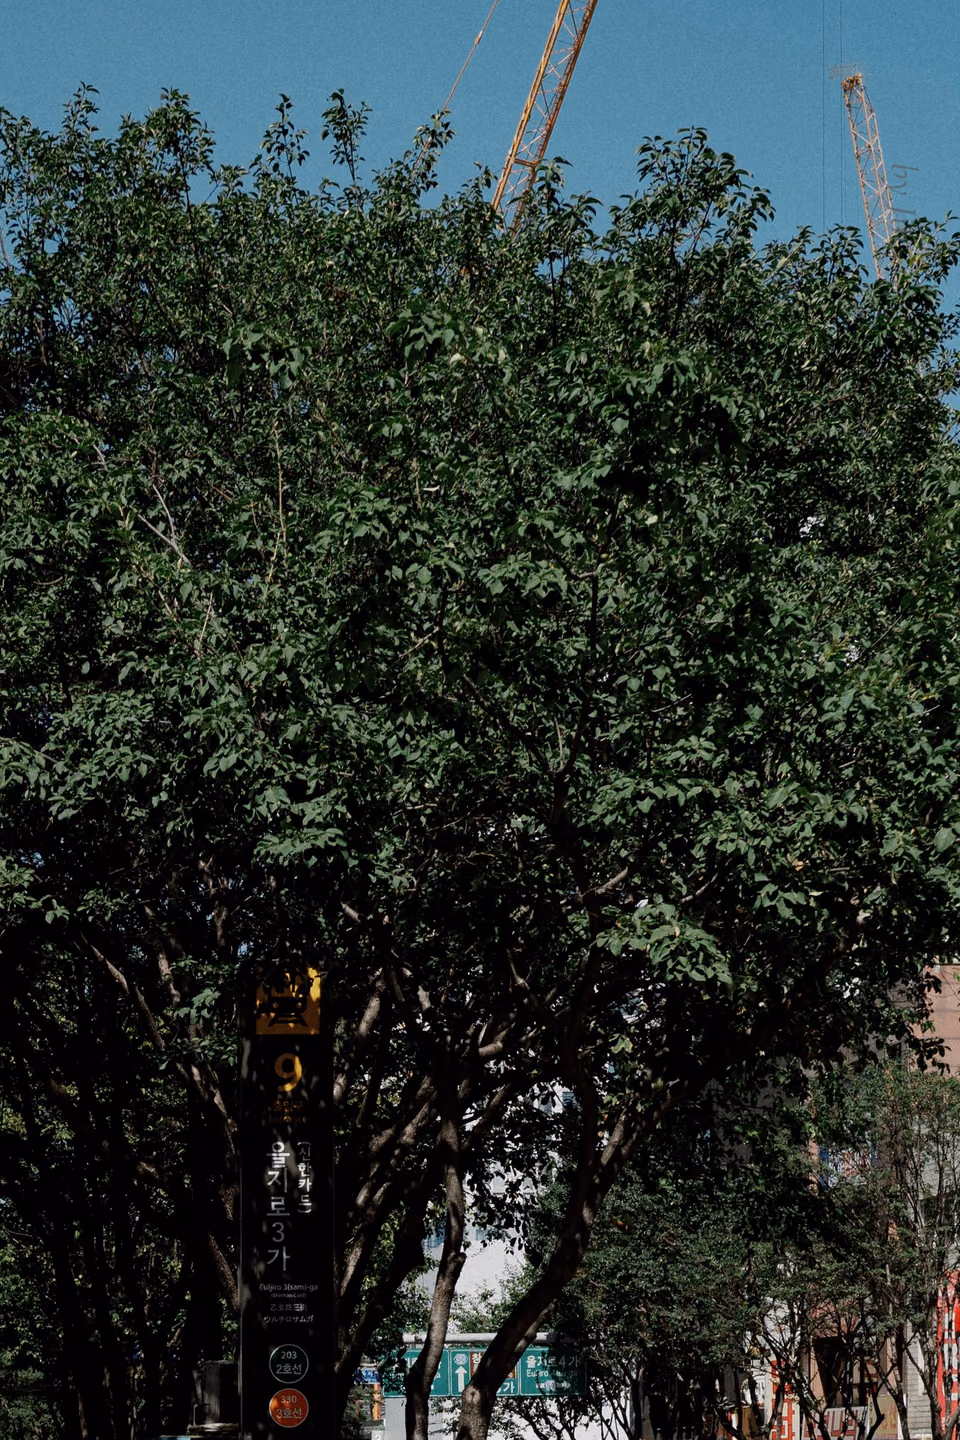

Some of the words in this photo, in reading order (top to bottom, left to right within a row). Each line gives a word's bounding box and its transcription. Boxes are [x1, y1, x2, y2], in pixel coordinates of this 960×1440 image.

[275, 1053, 302, 1092] 9
[296, 1141, 313, 1214] (신한카드)
[266, 1141, 291, 1271] 을지로3가
[259, 1283, 282, 1293] Euljiro
[283, 1283, 319, 1293] 3(sam)-ga
[280, 1351, 298, 1360] 203
[276, 1363, 303, 1375] 2호선
[280, 1395, 298, 1404] 330
[276, 1408, 303, 1419] 3호선
